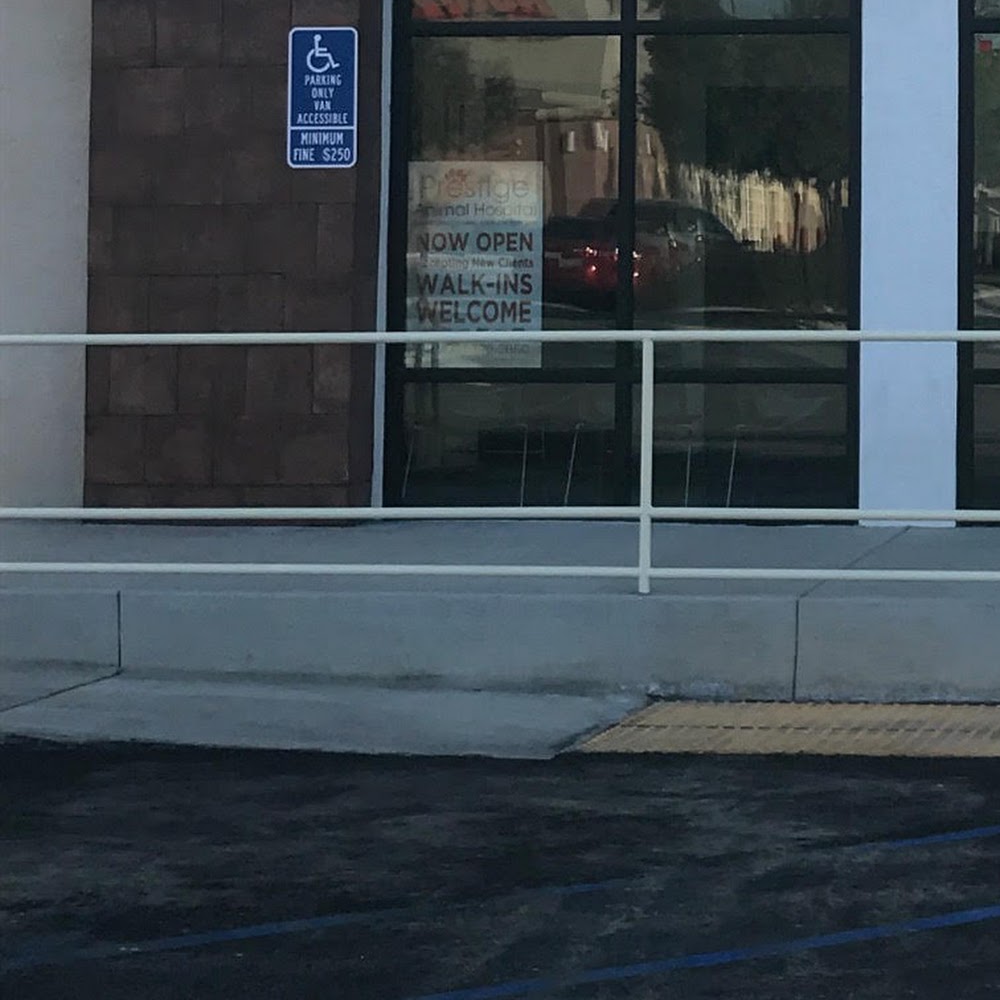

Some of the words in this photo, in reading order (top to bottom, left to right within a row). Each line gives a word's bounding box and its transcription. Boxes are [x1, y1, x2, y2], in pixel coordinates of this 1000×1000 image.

[304, 74, 342, 86] PARKING
[311, 87, 335, 99] ONLY
[313, 100, 332, 111] VAN
[296, 112, 348, 124] ACCESSIBLE
[300, 132, 344, 146] MINIMUM
[293, 147, 315, 162] FINE
[417, 232, 470, 252] NOW
[475, 232, 534, 252] OPEN
[416, 273, 533, 295] WALK-INS
[416, 300, 532, 323] WELCOME
